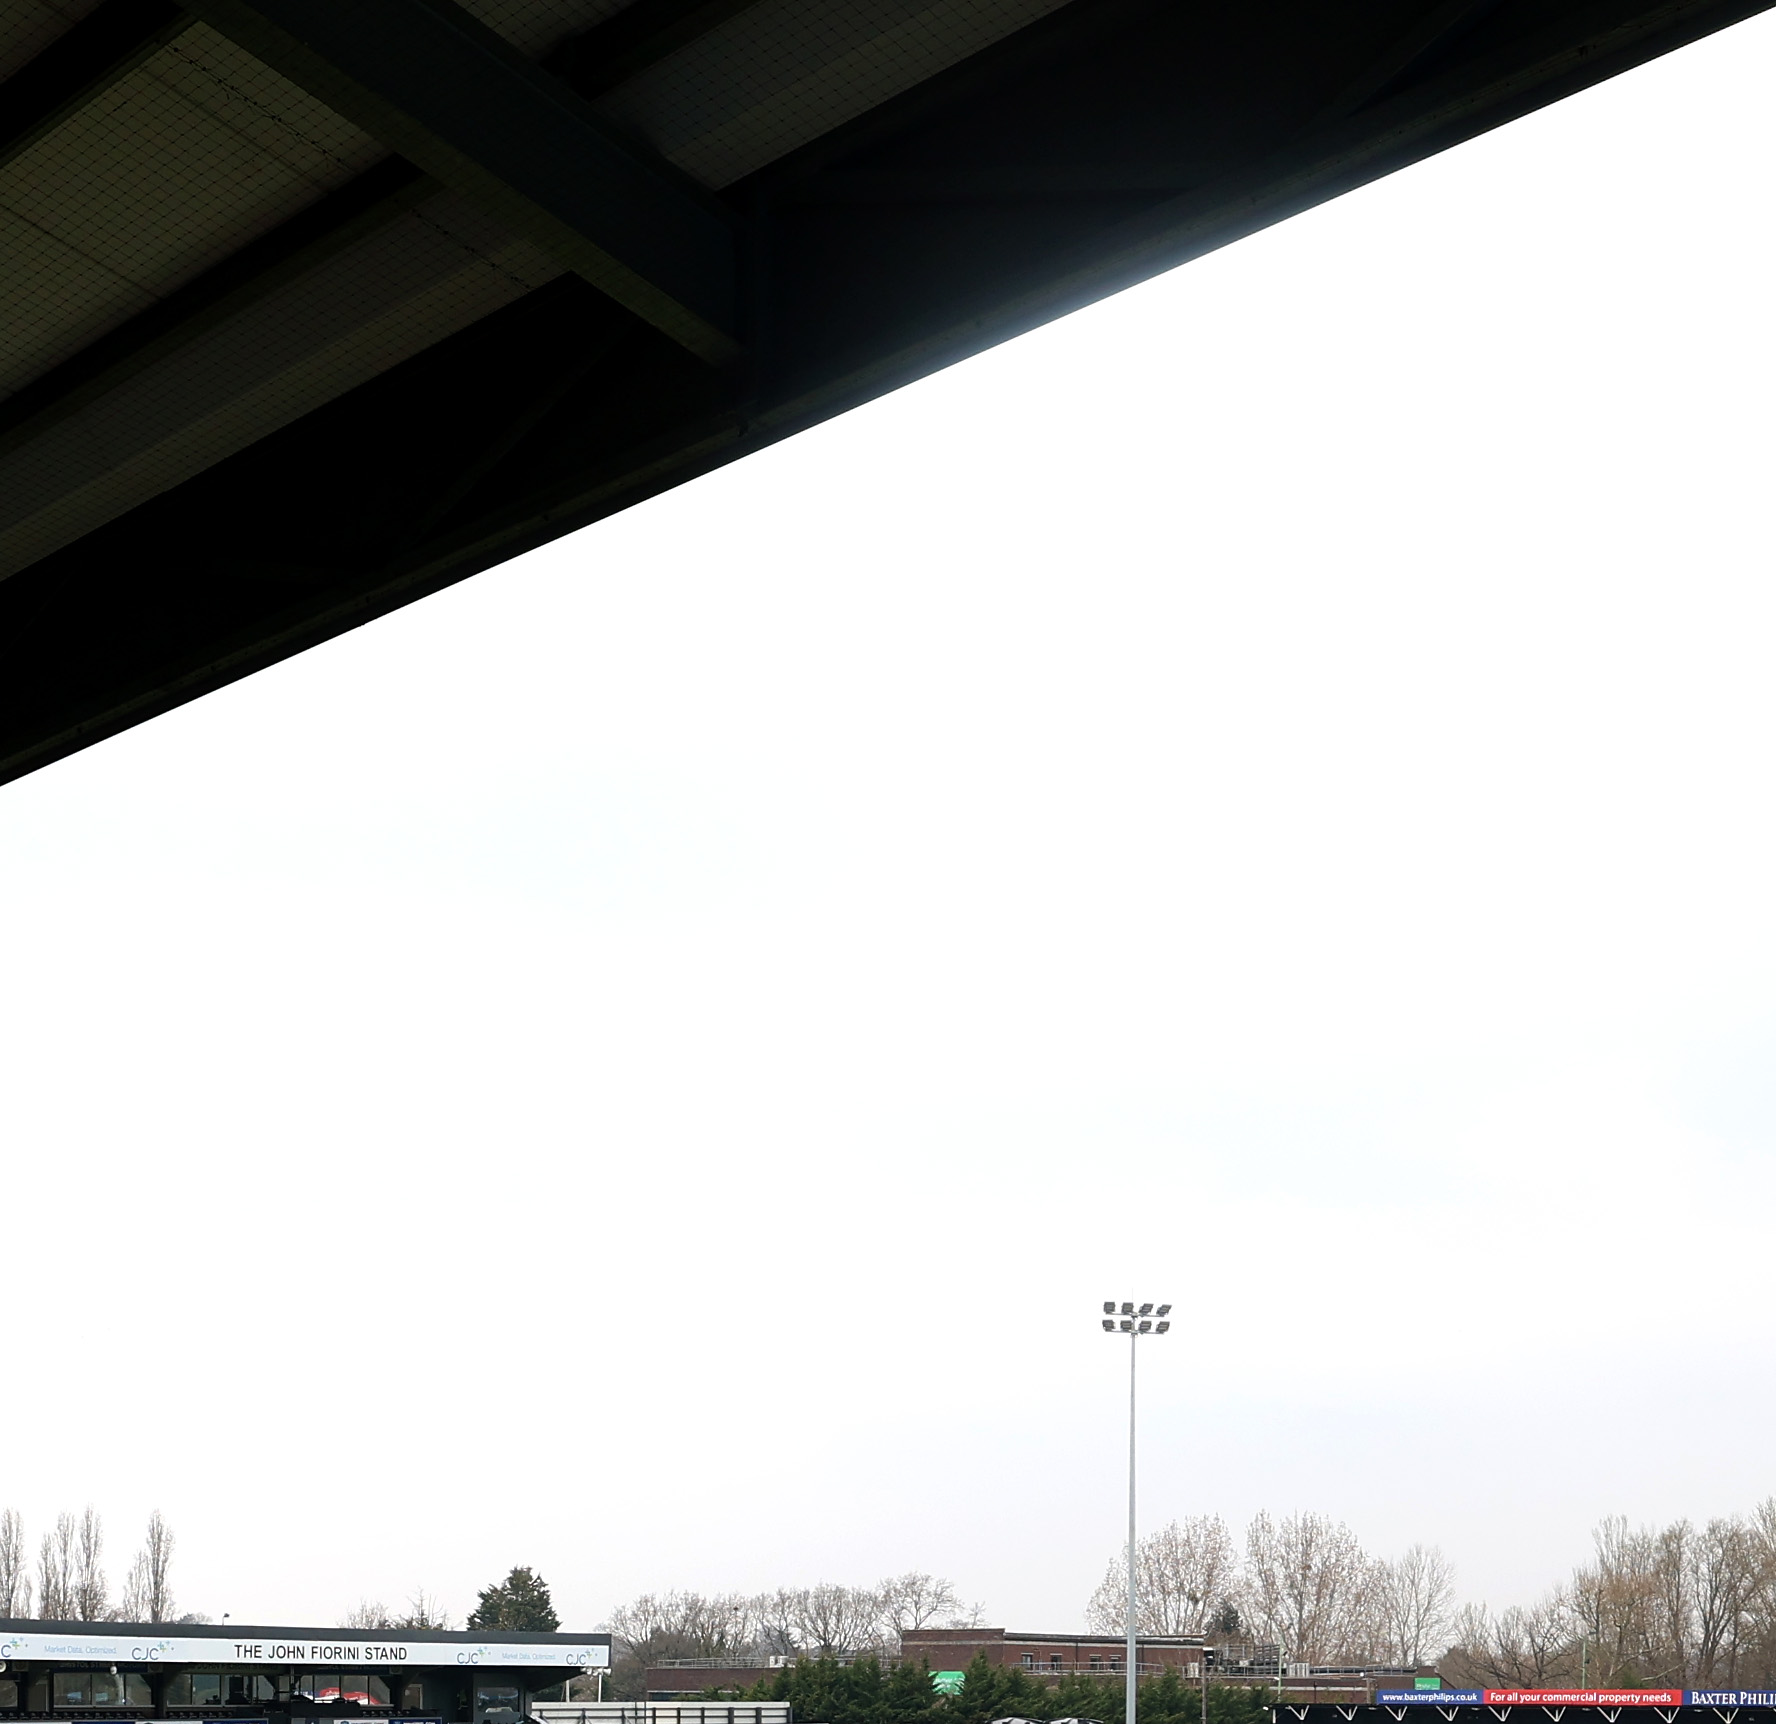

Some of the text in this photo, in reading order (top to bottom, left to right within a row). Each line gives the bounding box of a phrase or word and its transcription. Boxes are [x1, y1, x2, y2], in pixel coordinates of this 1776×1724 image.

[131, 1646, 159, 1661] CJC
[234, 1644, 408, 1661] THE JOHN FIORINI STAND
[456, 1651, 479, 1665] CJC
[565, 1653, 586, 1666] CJC
[1382, 1692, 1478, 1703] www.baxterphilips.co.uk
[1490, 1691, 1672, 1705] For all your commercial property needs
[1691, 1691, 1738, 1706] BAXTER
